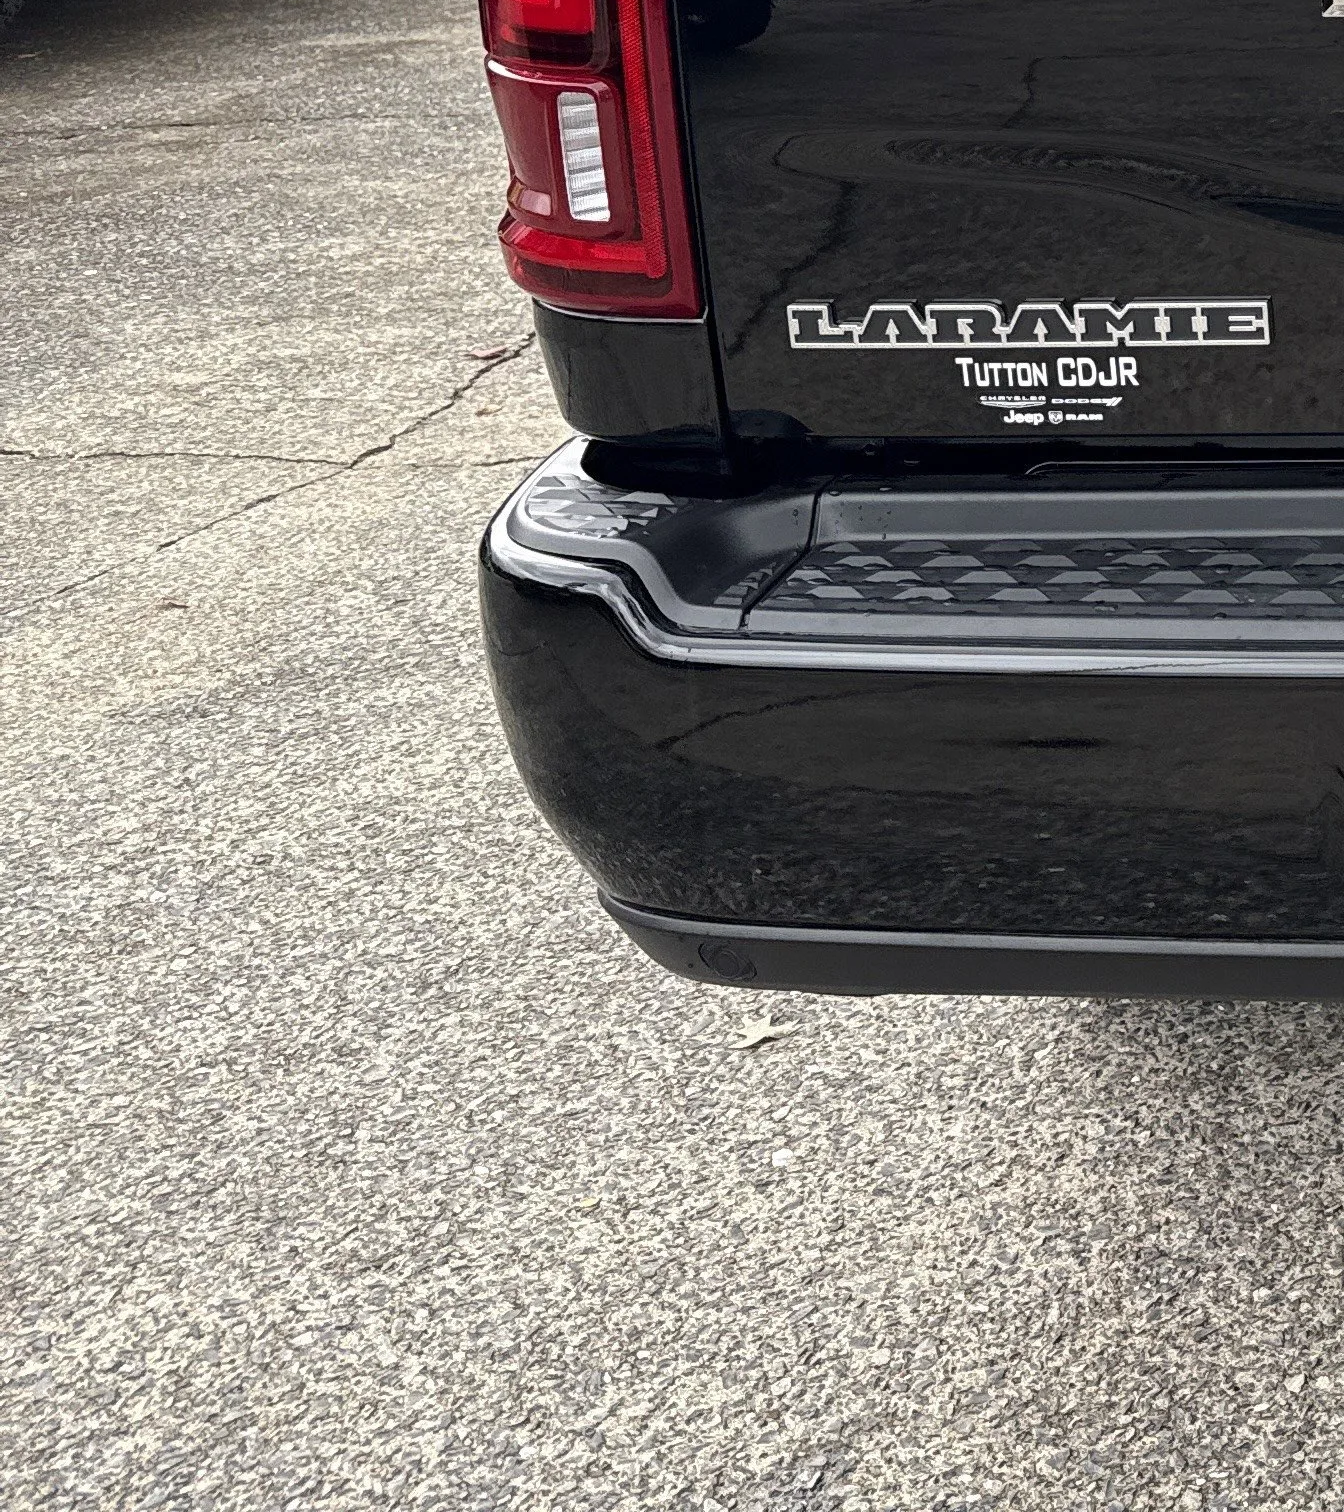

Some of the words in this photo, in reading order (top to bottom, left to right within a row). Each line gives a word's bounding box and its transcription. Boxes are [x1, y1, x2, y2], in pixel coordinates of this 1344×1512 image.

[786, 296, 1274, 348] LARAMIE
[1056, 356, 1140, 386] CDJR
[1003, 410, 1045, 426] Jeep
[1065, 413, 1104, 421] RAM
